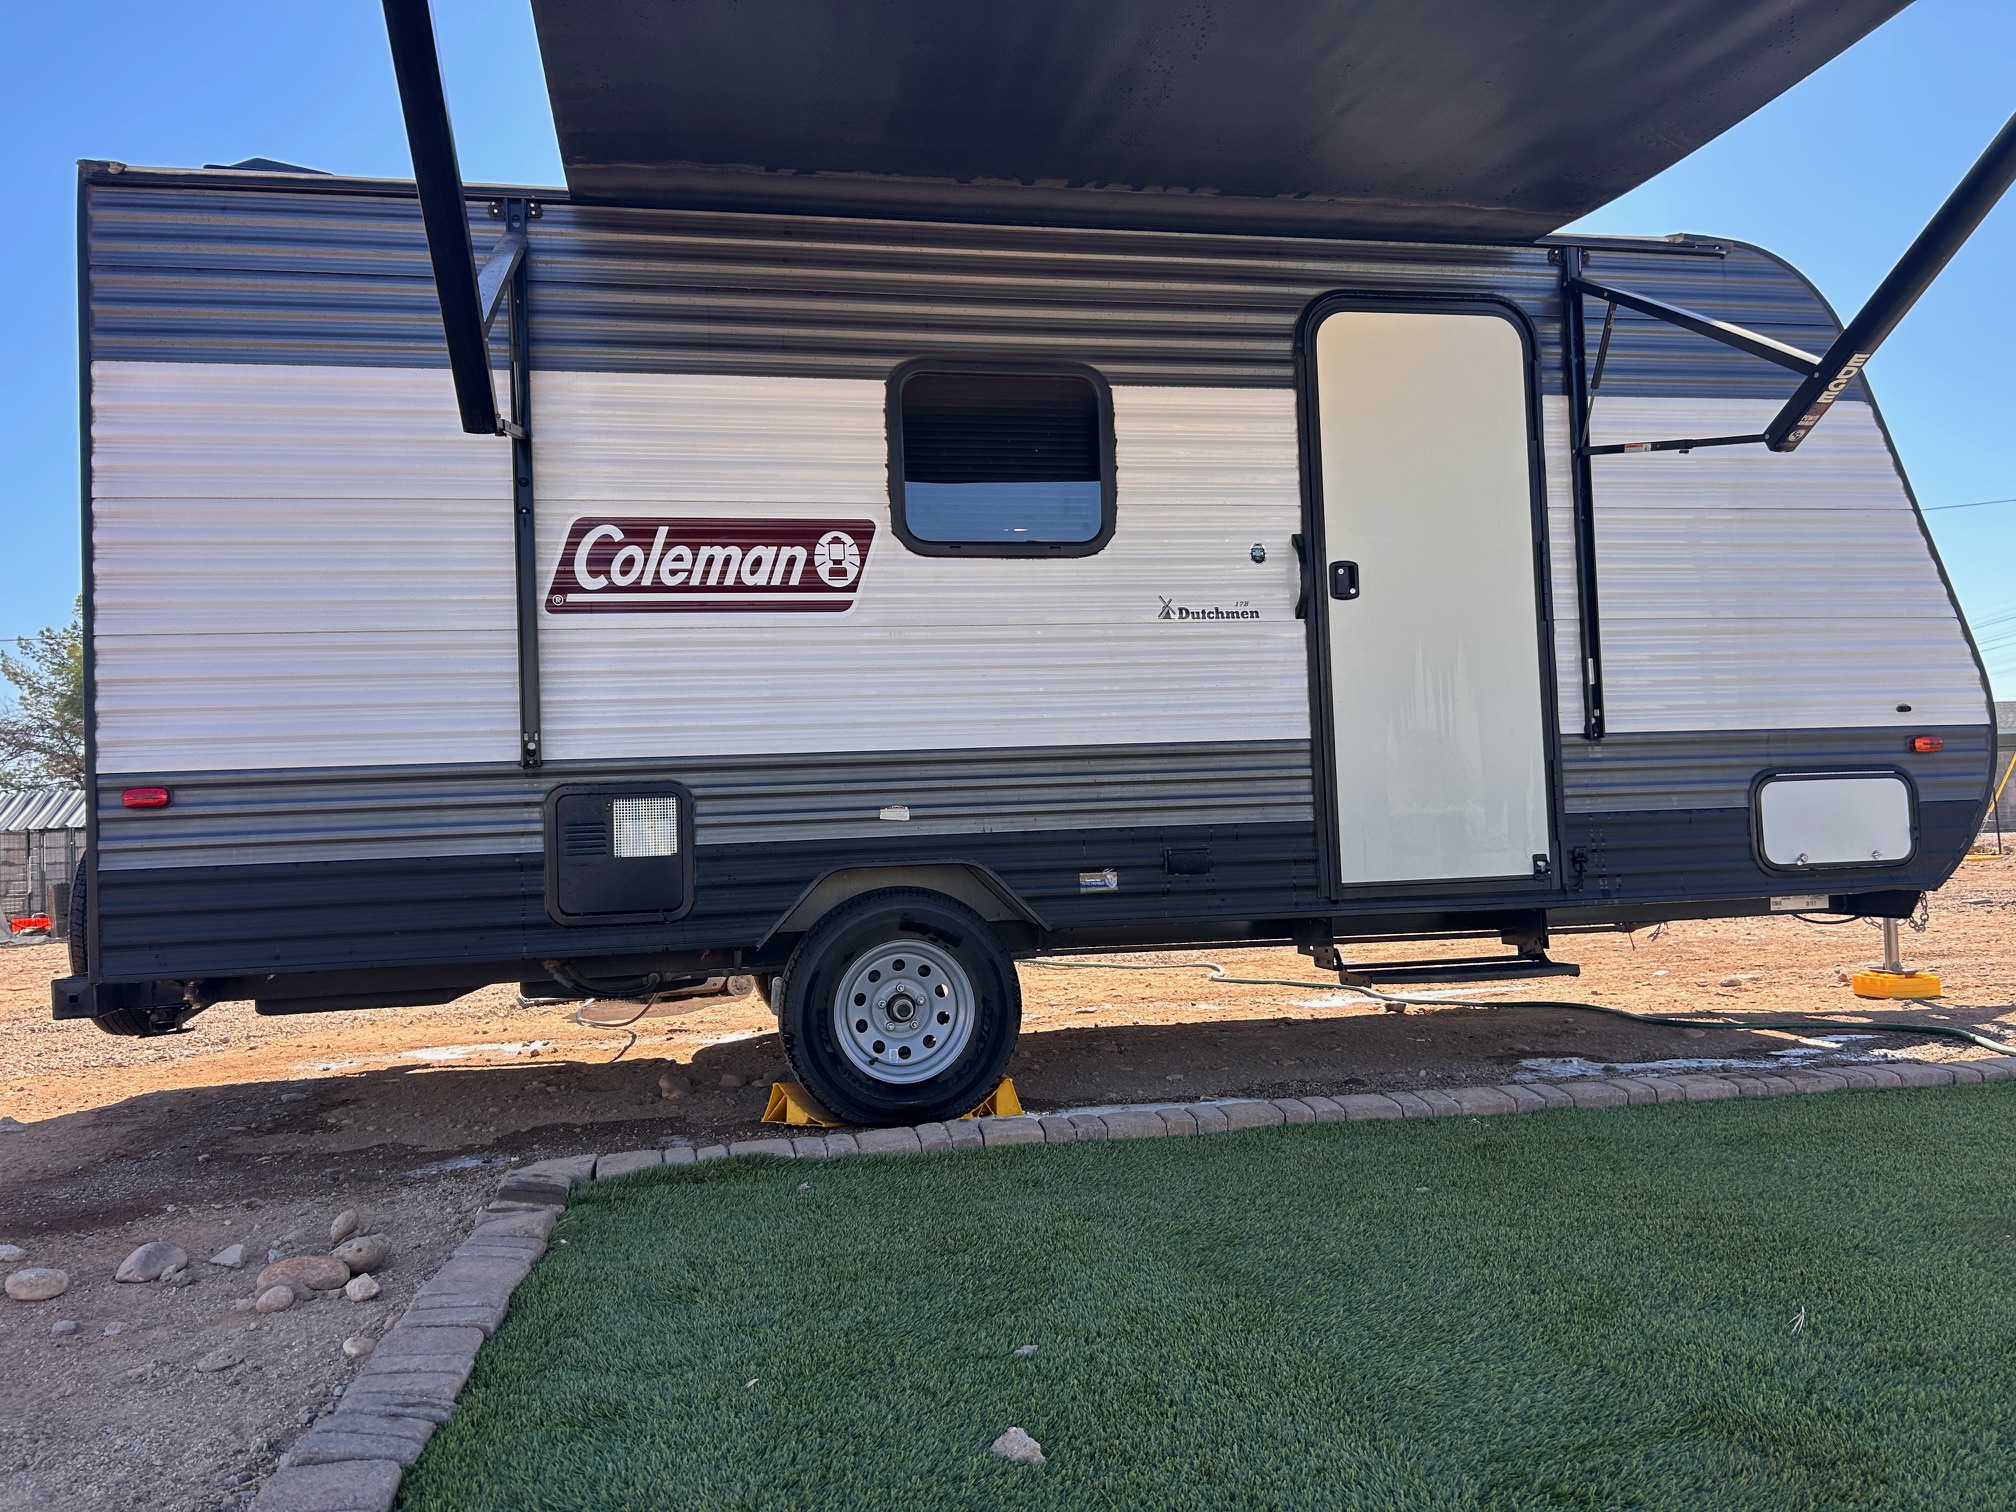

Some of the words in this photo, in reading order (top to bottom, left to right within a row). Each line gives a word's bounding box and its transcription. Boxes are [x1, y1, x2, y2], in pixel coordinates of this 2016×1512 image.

[1816, 353, 1871, 403] EDGE
[573, 524, 808, 591] Coleman
[1177, 606, 1260, 620] Dutchmen
